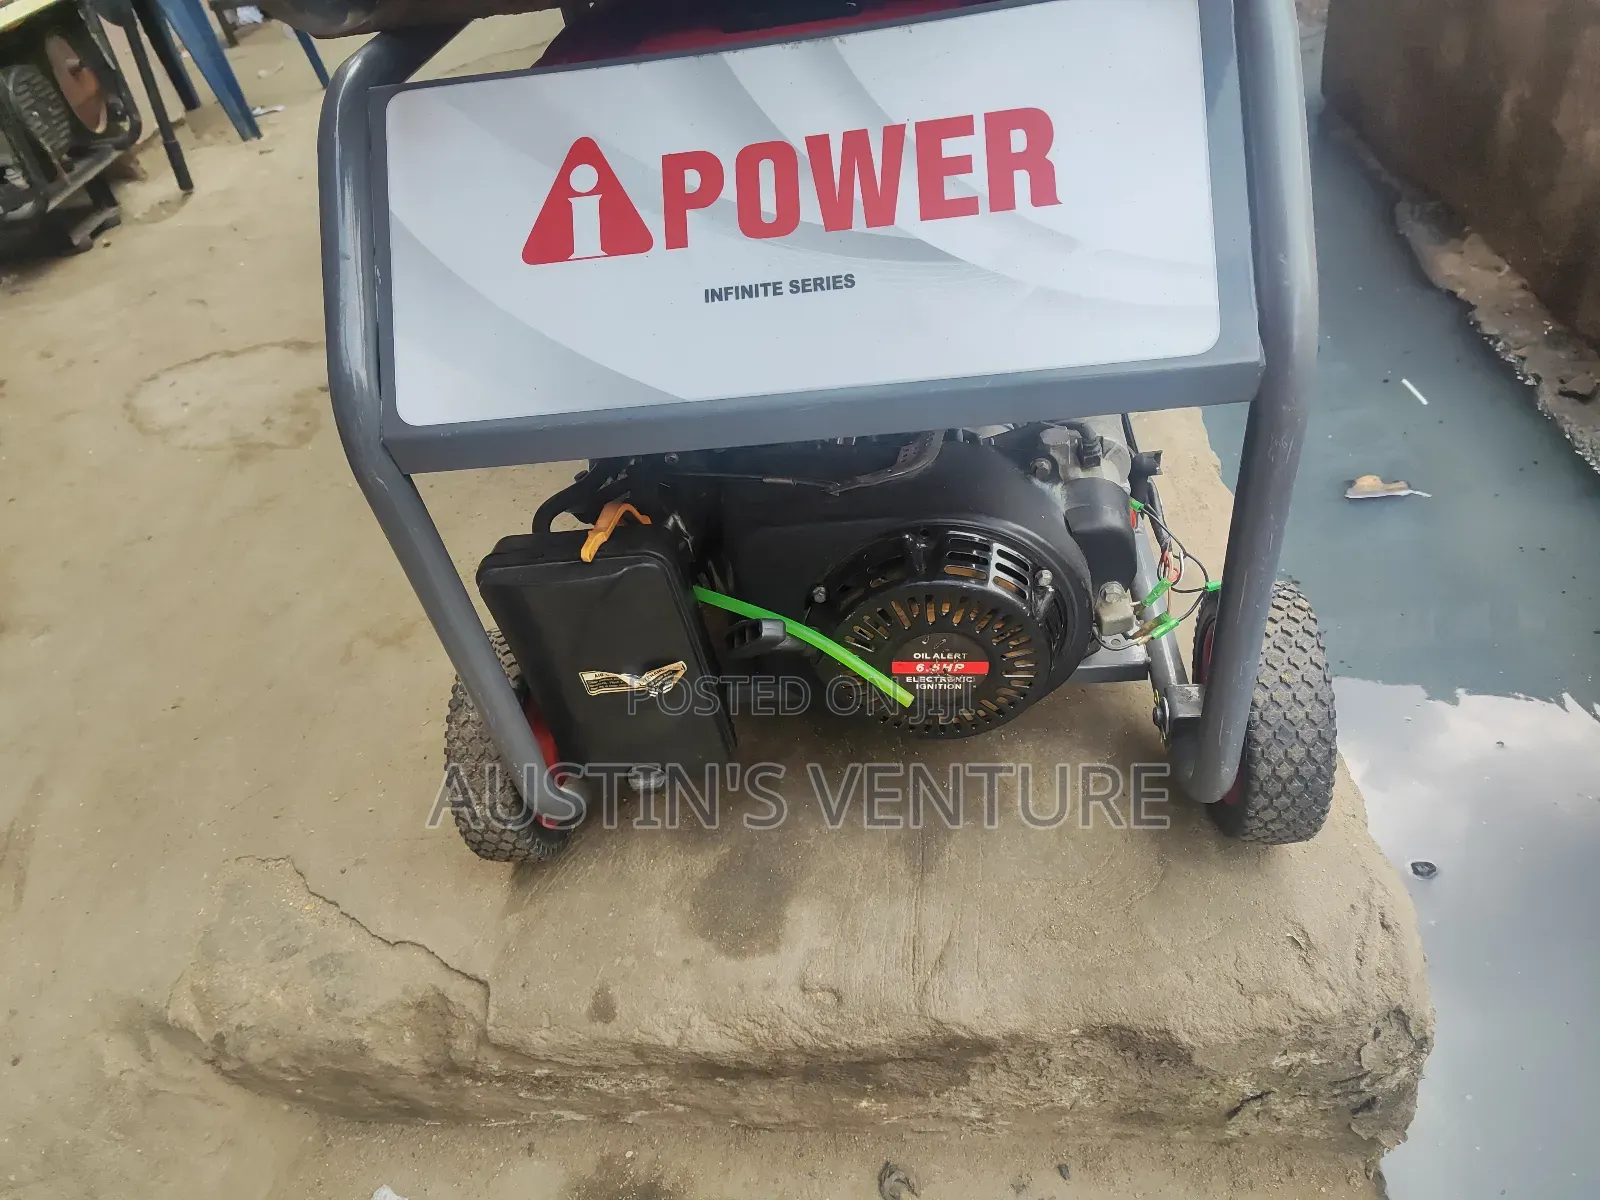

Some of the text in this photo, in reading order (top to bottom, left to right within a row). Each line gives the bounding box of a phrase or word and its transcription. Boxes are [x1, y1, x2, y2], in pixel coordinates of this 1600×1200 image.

[661, 107, 1063, 250] POWER
[704, 273, 856, 303] INFINITE SERIES
[913, 652, 968, 660] OIL ALERT
[905, 675, 974, 683] ELECTRONIC
